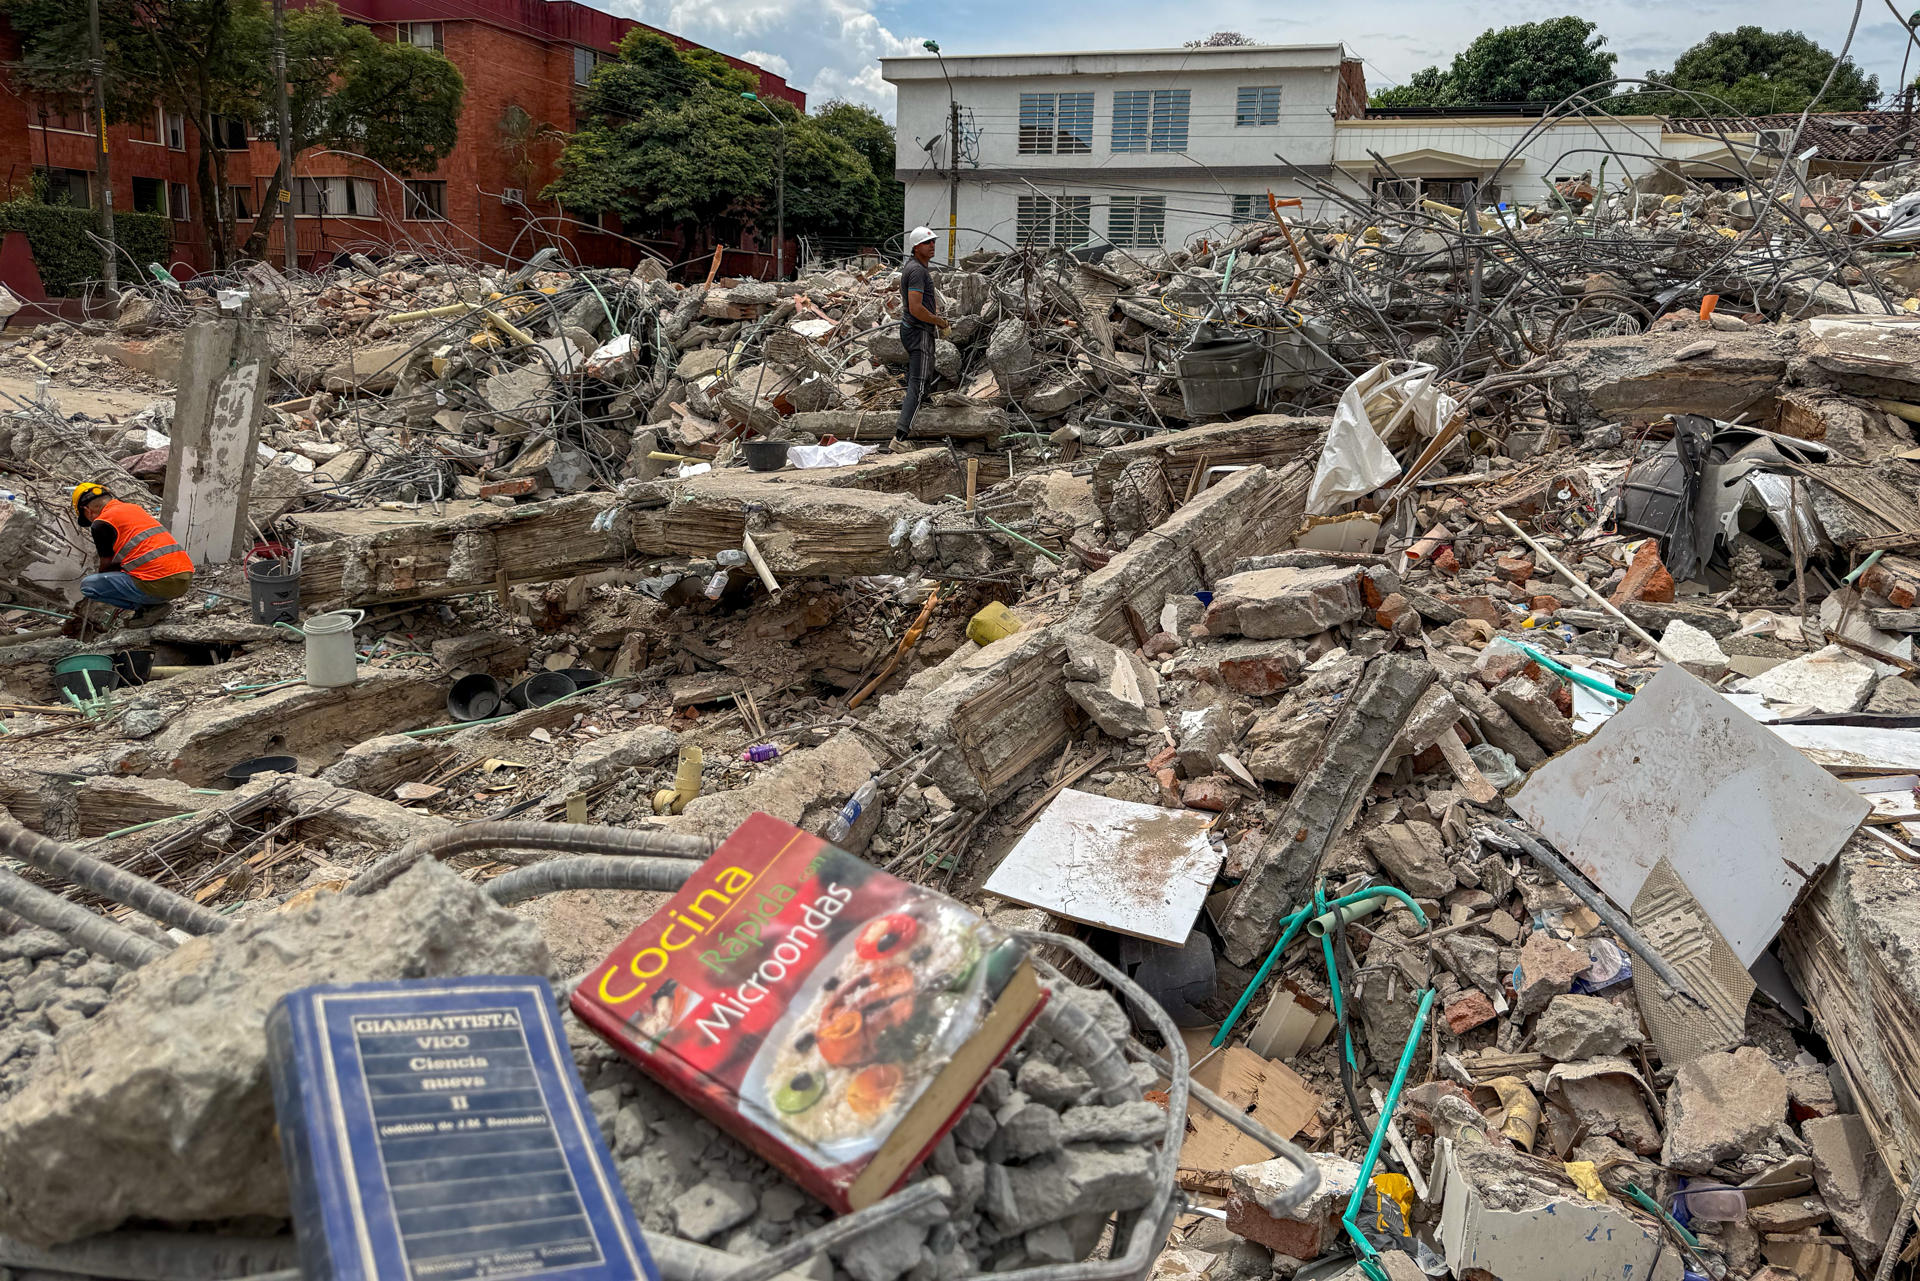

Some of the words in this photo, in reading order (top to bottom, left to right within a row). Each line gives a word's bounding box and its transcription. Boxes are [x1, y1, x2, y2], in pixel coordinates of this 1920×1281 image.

[599, 866, 753, 1004] Cocina
[699, 882, 797, 973] Rápida
[695, 881, 853, 1044] Microondas
[356, 1013, 518, 1033] GIAMBATTISTA
[416, 1034, 471, 1050] VICO
[409, 1055, 488, 1072] Ciencia
[421, 1074, 486, 1091] nueva
